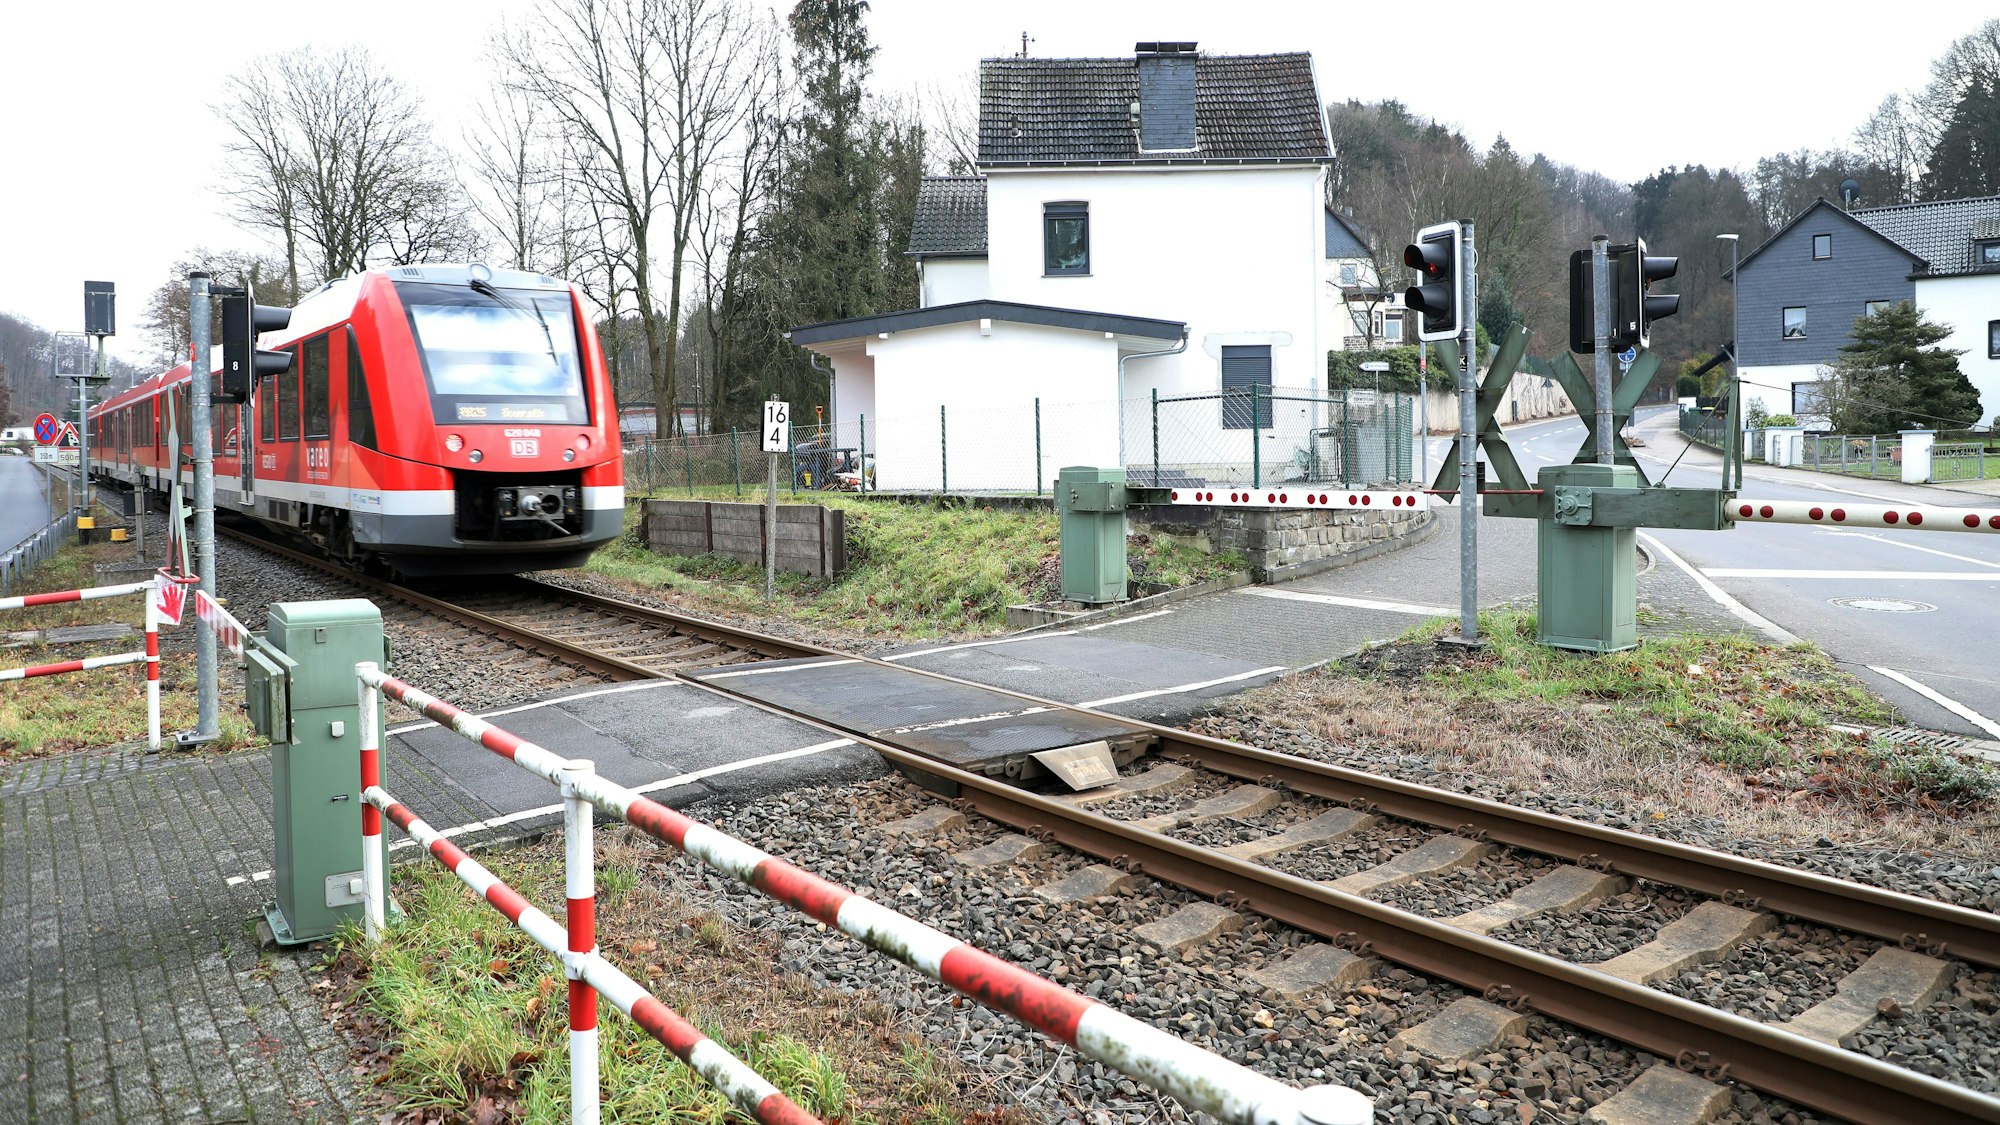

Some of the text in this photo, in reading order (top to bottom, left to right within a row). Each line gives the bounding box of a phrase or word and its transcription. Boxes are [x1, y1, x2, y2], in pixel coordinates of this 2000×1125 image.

[232, 361, 239, 371] 8
[768, 406, 786, 423] 16
[769, 427, 780, 444] 4
[306, 447, 328, 468] vareo
